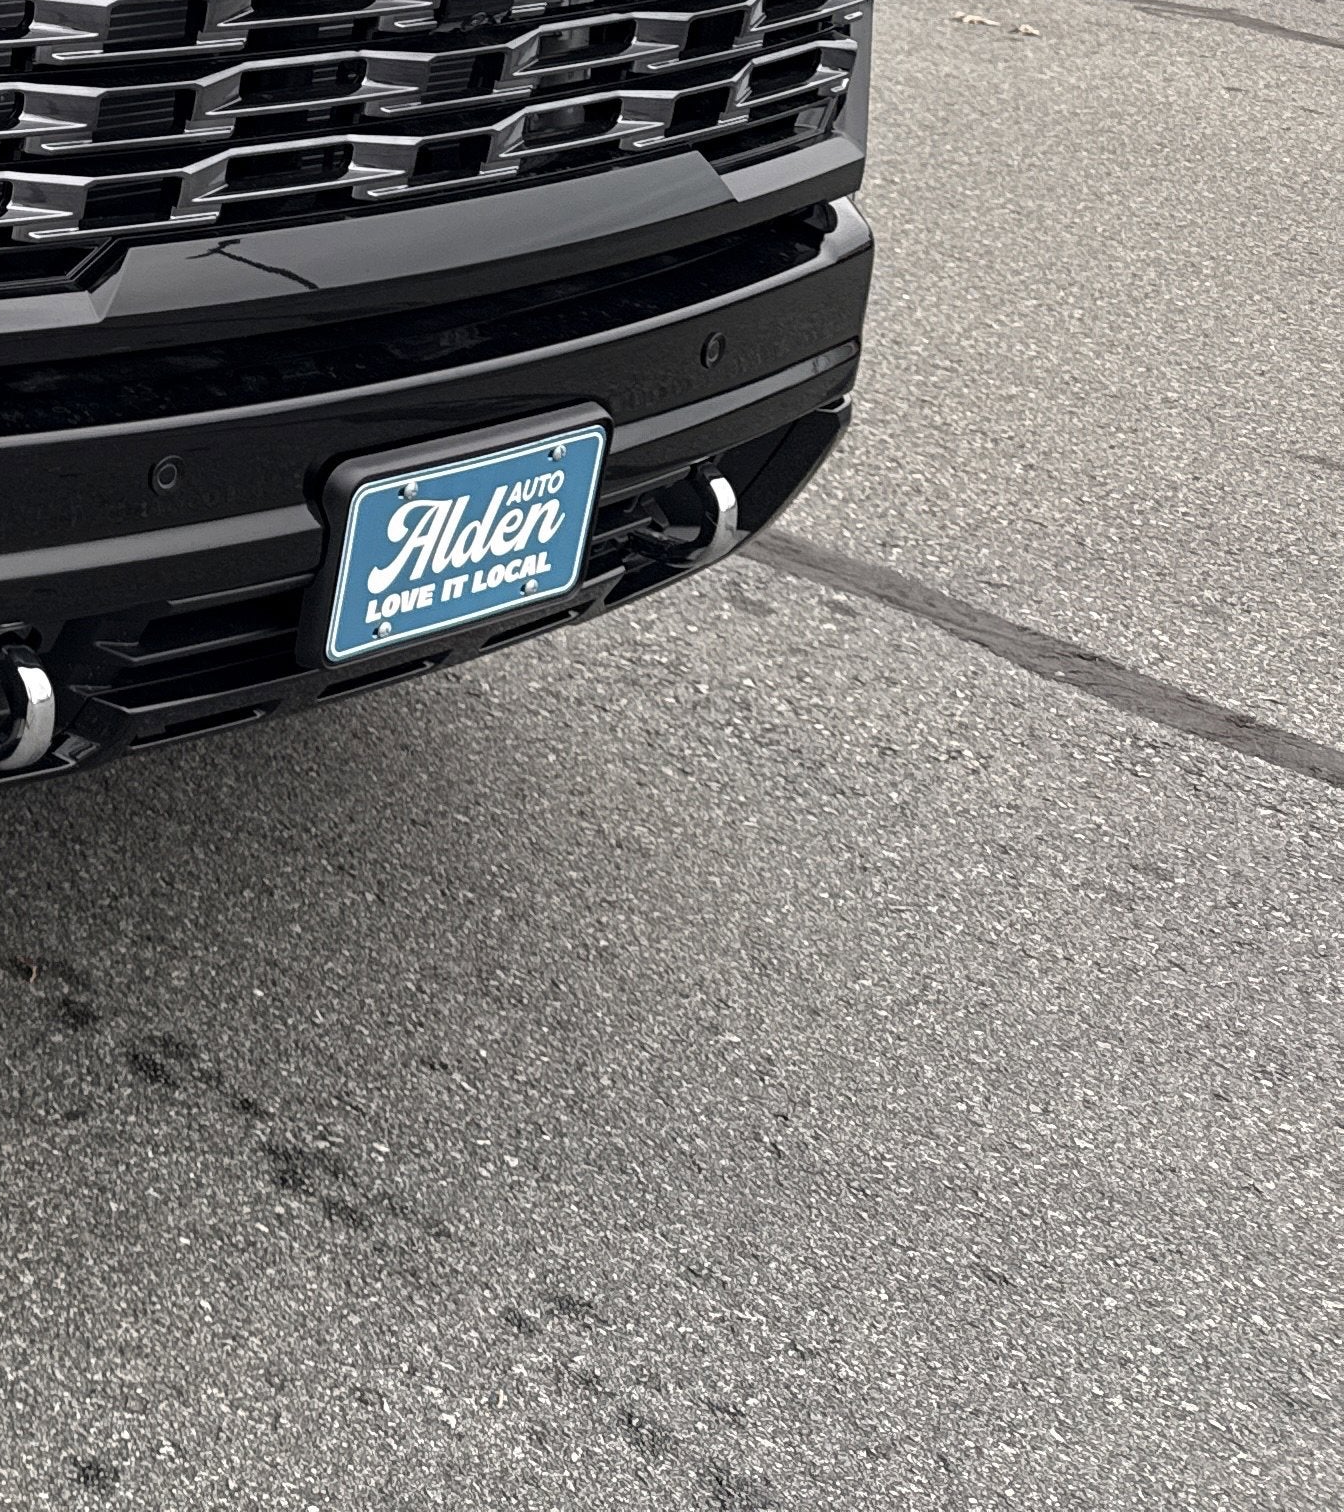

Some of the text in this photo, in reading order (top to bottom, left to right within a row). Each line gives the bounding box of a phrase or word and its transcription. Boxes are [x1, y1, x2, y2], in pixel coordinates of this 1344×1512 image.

[505, 469, 565, 506] AUTO
[367, 485, 566, 594] Alden
[365, 551, 552, 624] LOVE IT LOCAL
